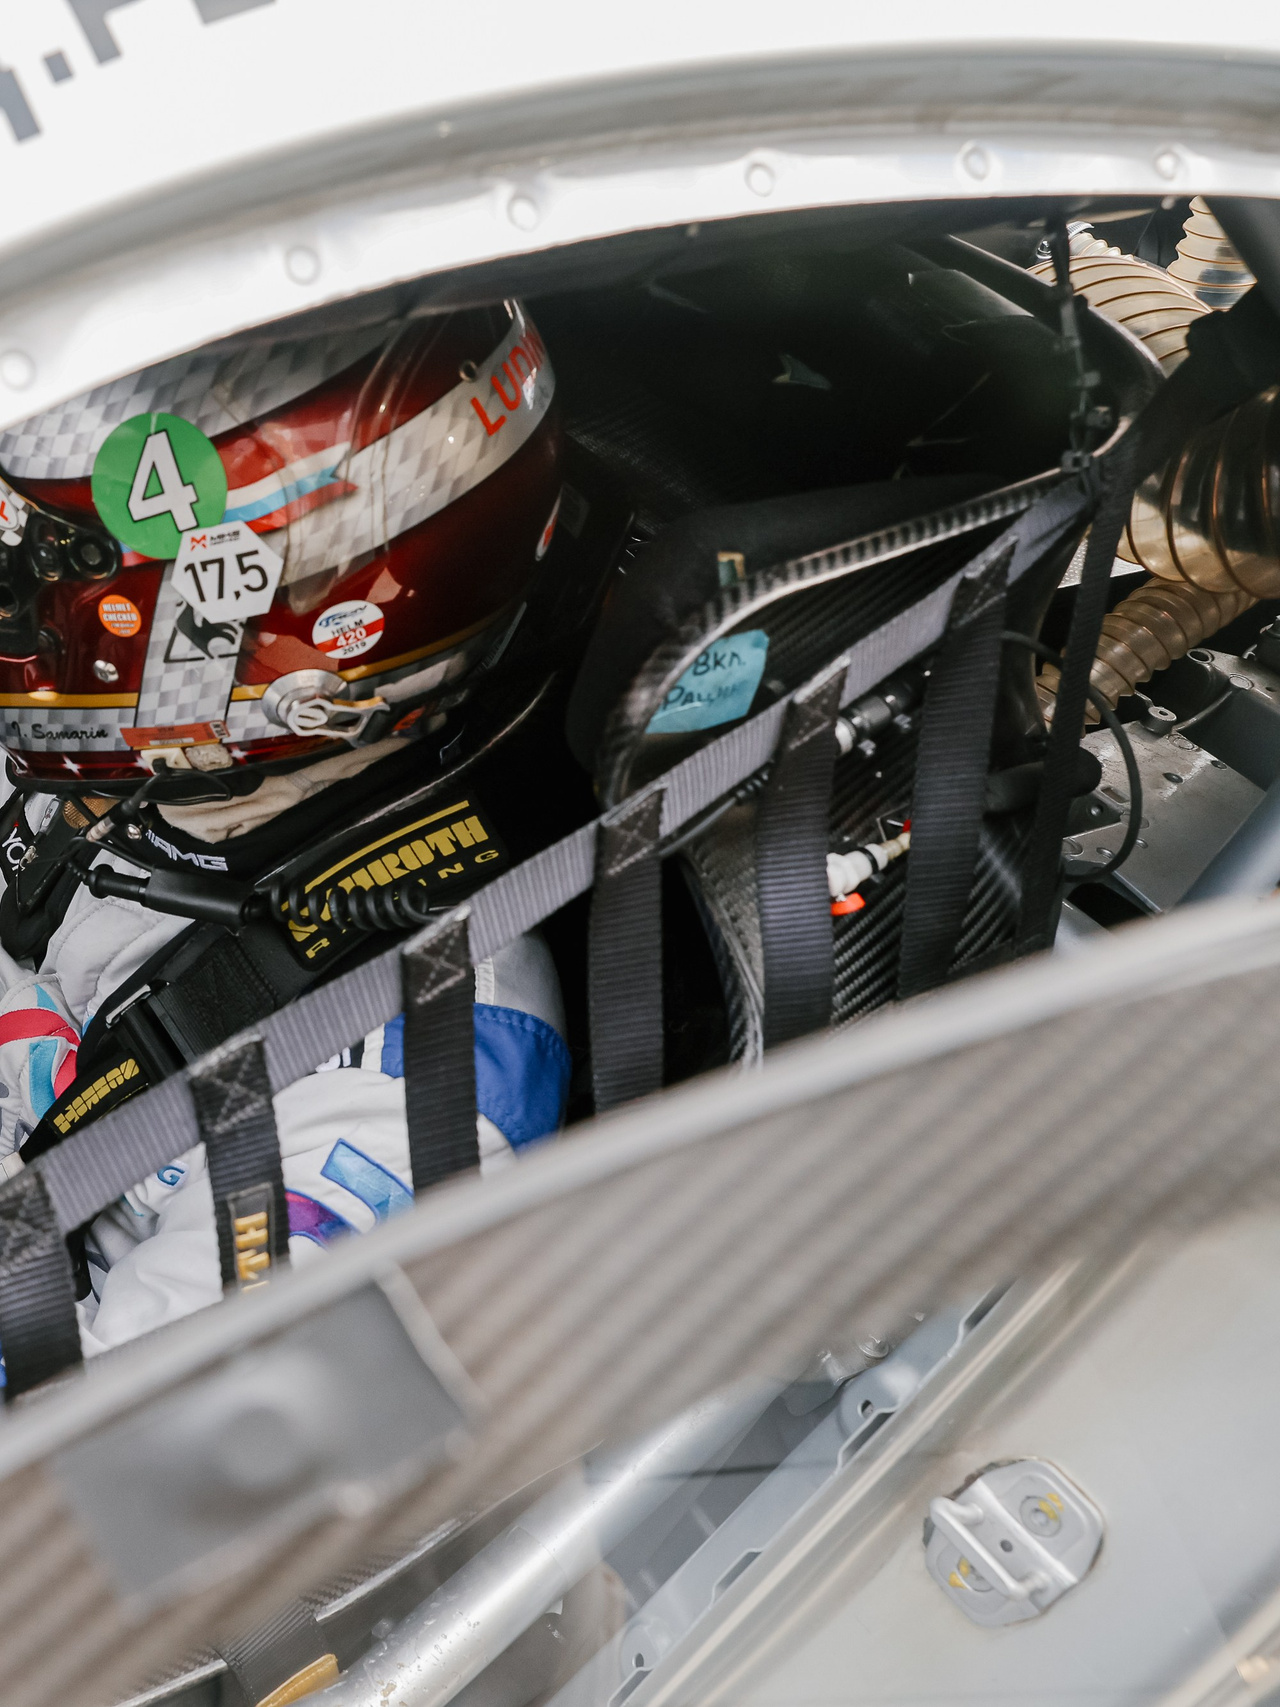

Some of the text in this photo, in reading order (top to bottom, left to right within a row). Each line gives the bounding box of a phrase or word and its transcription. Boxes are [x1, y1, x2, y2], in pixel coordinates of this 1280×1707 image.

[127, 429, 199, 533] 4
[184, 550, 268, 602] 17,5
[331, 619, 363, 636] HELM
[336, 626, 367, 648] 420
[343, 641, 367, 655] 2019
[31, 723, 108, 740] Samarin
[153, 835, 228, 872] AMG
